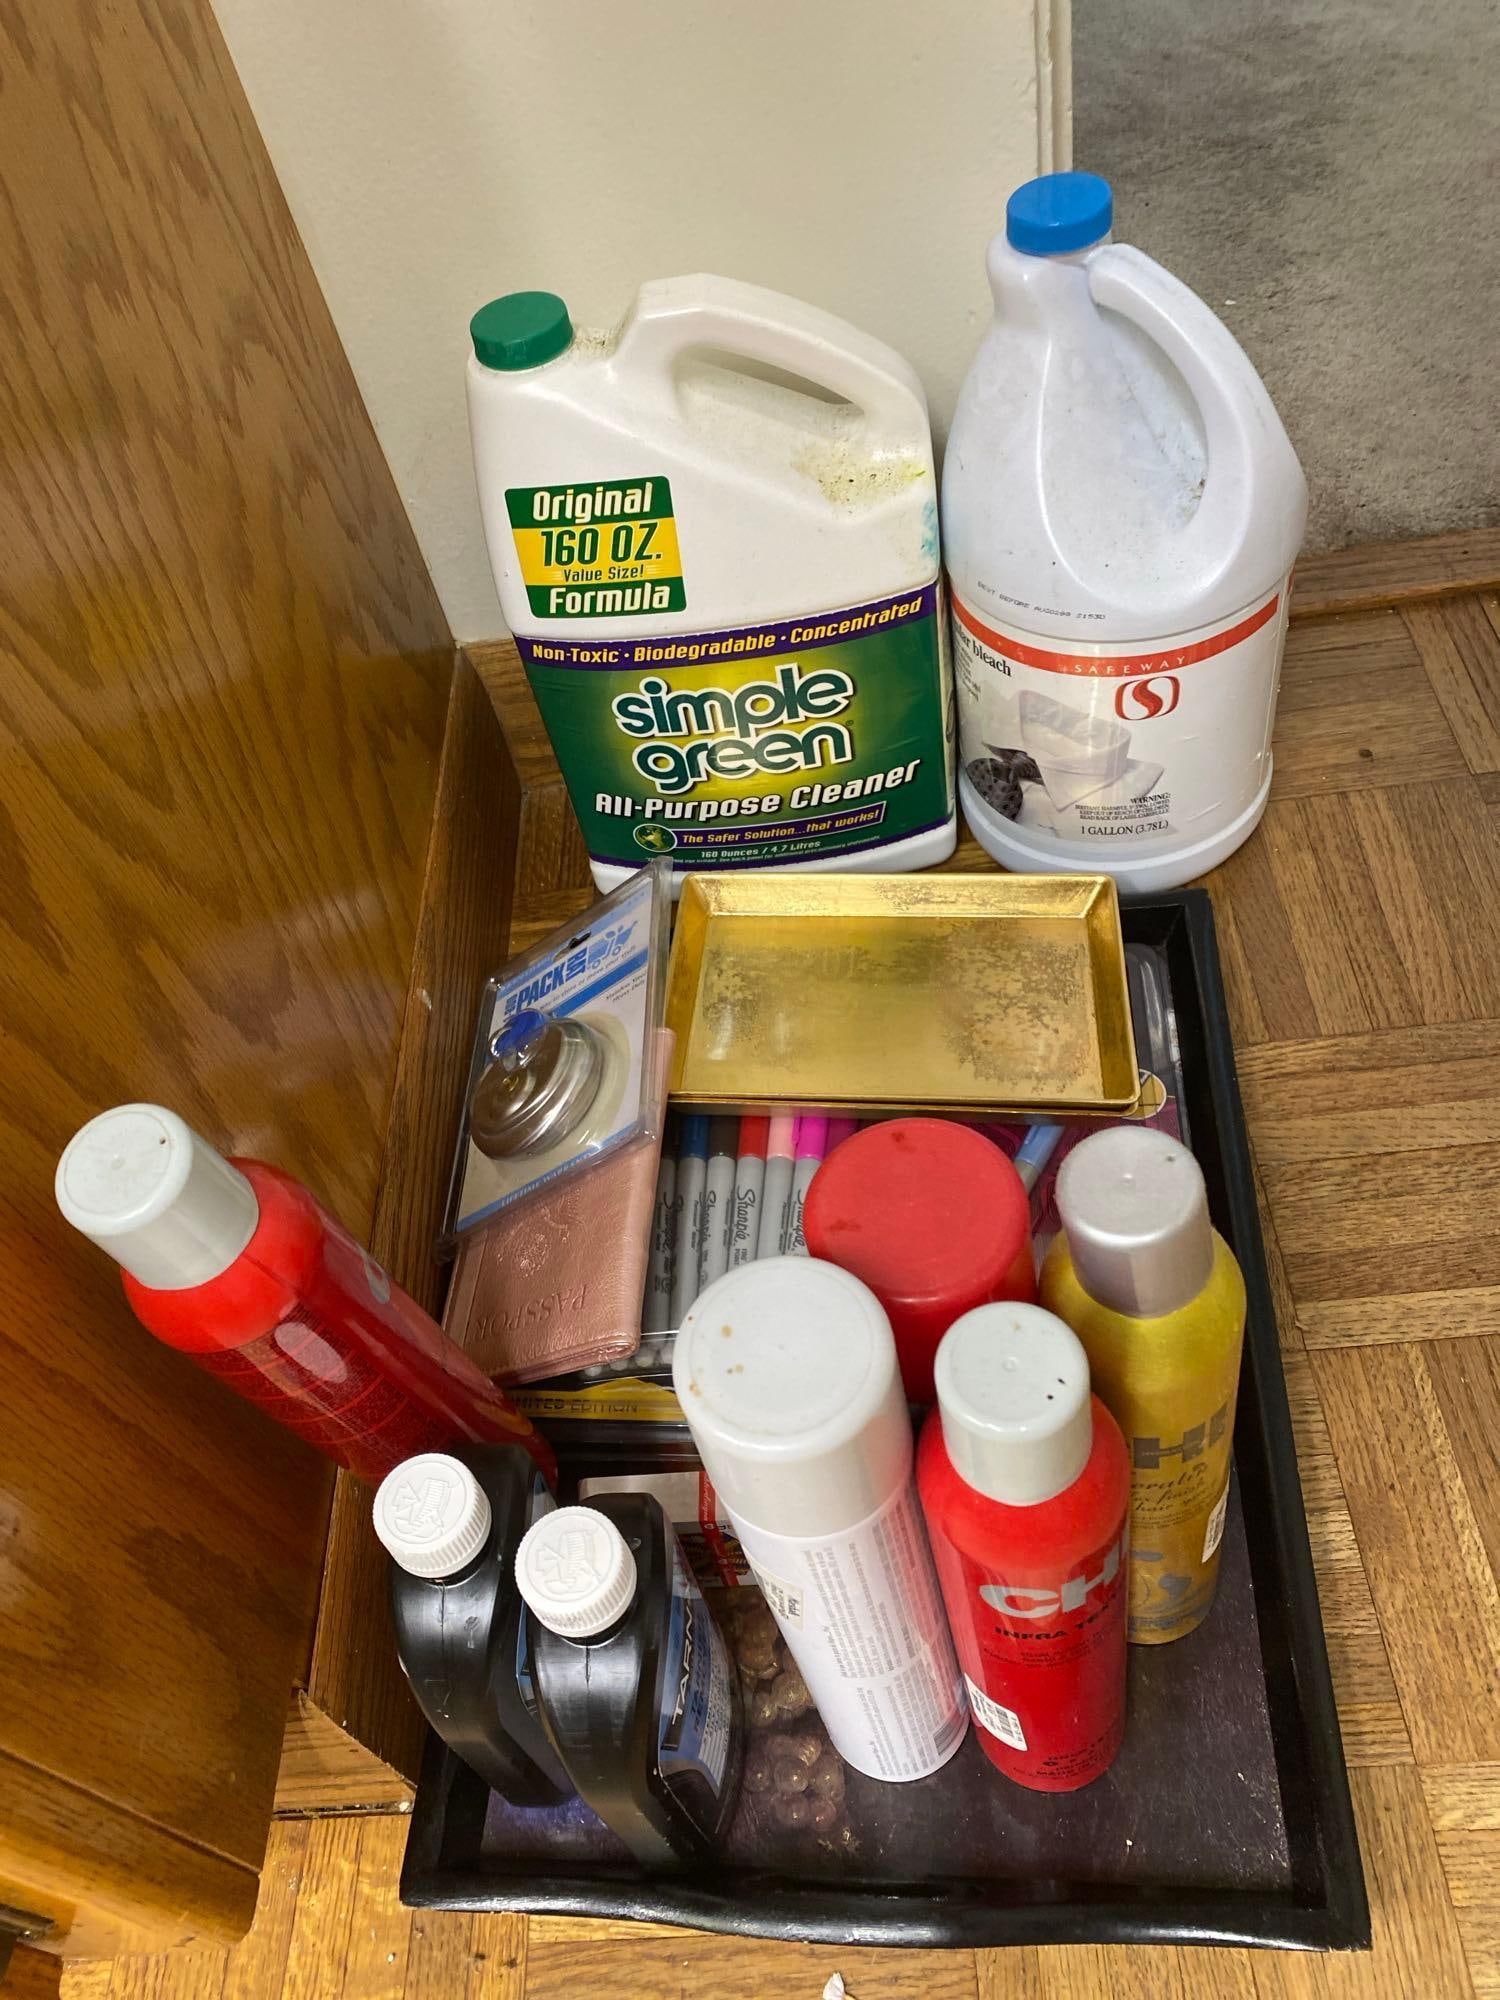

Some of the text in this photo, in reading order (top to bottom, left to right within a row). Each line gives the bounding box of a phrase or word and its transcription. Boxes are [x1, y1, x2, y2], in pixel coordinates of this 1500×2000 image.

[532, 481, 653, 524] Original
[540, 521, 662, 567] 160 OZ.
[563, 564, 644, 583] Value Size!
[549, 581, 671, 614] Formula
[633, 633, 777, 662] Biodegradable
[790, 596, 923, 644] Concentrated
[972, 639, 1012, 678] bleach
[1074, 655, 1186, 674] SAFEWAY
[611, 662, 855, 739] simple
[631, 721, 855, 795] green
[595, 759, 921, 822] All-Purpose Cleaner
[682, 833, 703, 844] The
[707, 832, 740, 843] Safer
[835, 809, 879, 829] works!
[1087, 825, 1134, 836] GALLON
[1135, 819, 1169, 835] (3.78L)
[700, 850, 718, 859] 160
[721, 848, 759, 858] Ounces
[790, 840, 821, 851] Litres
[515, 962, 567, 1014] PACK
[474, 1283, 589, 1341] PASSPOR
[994, 1625, 1069, 1641] INFRA
